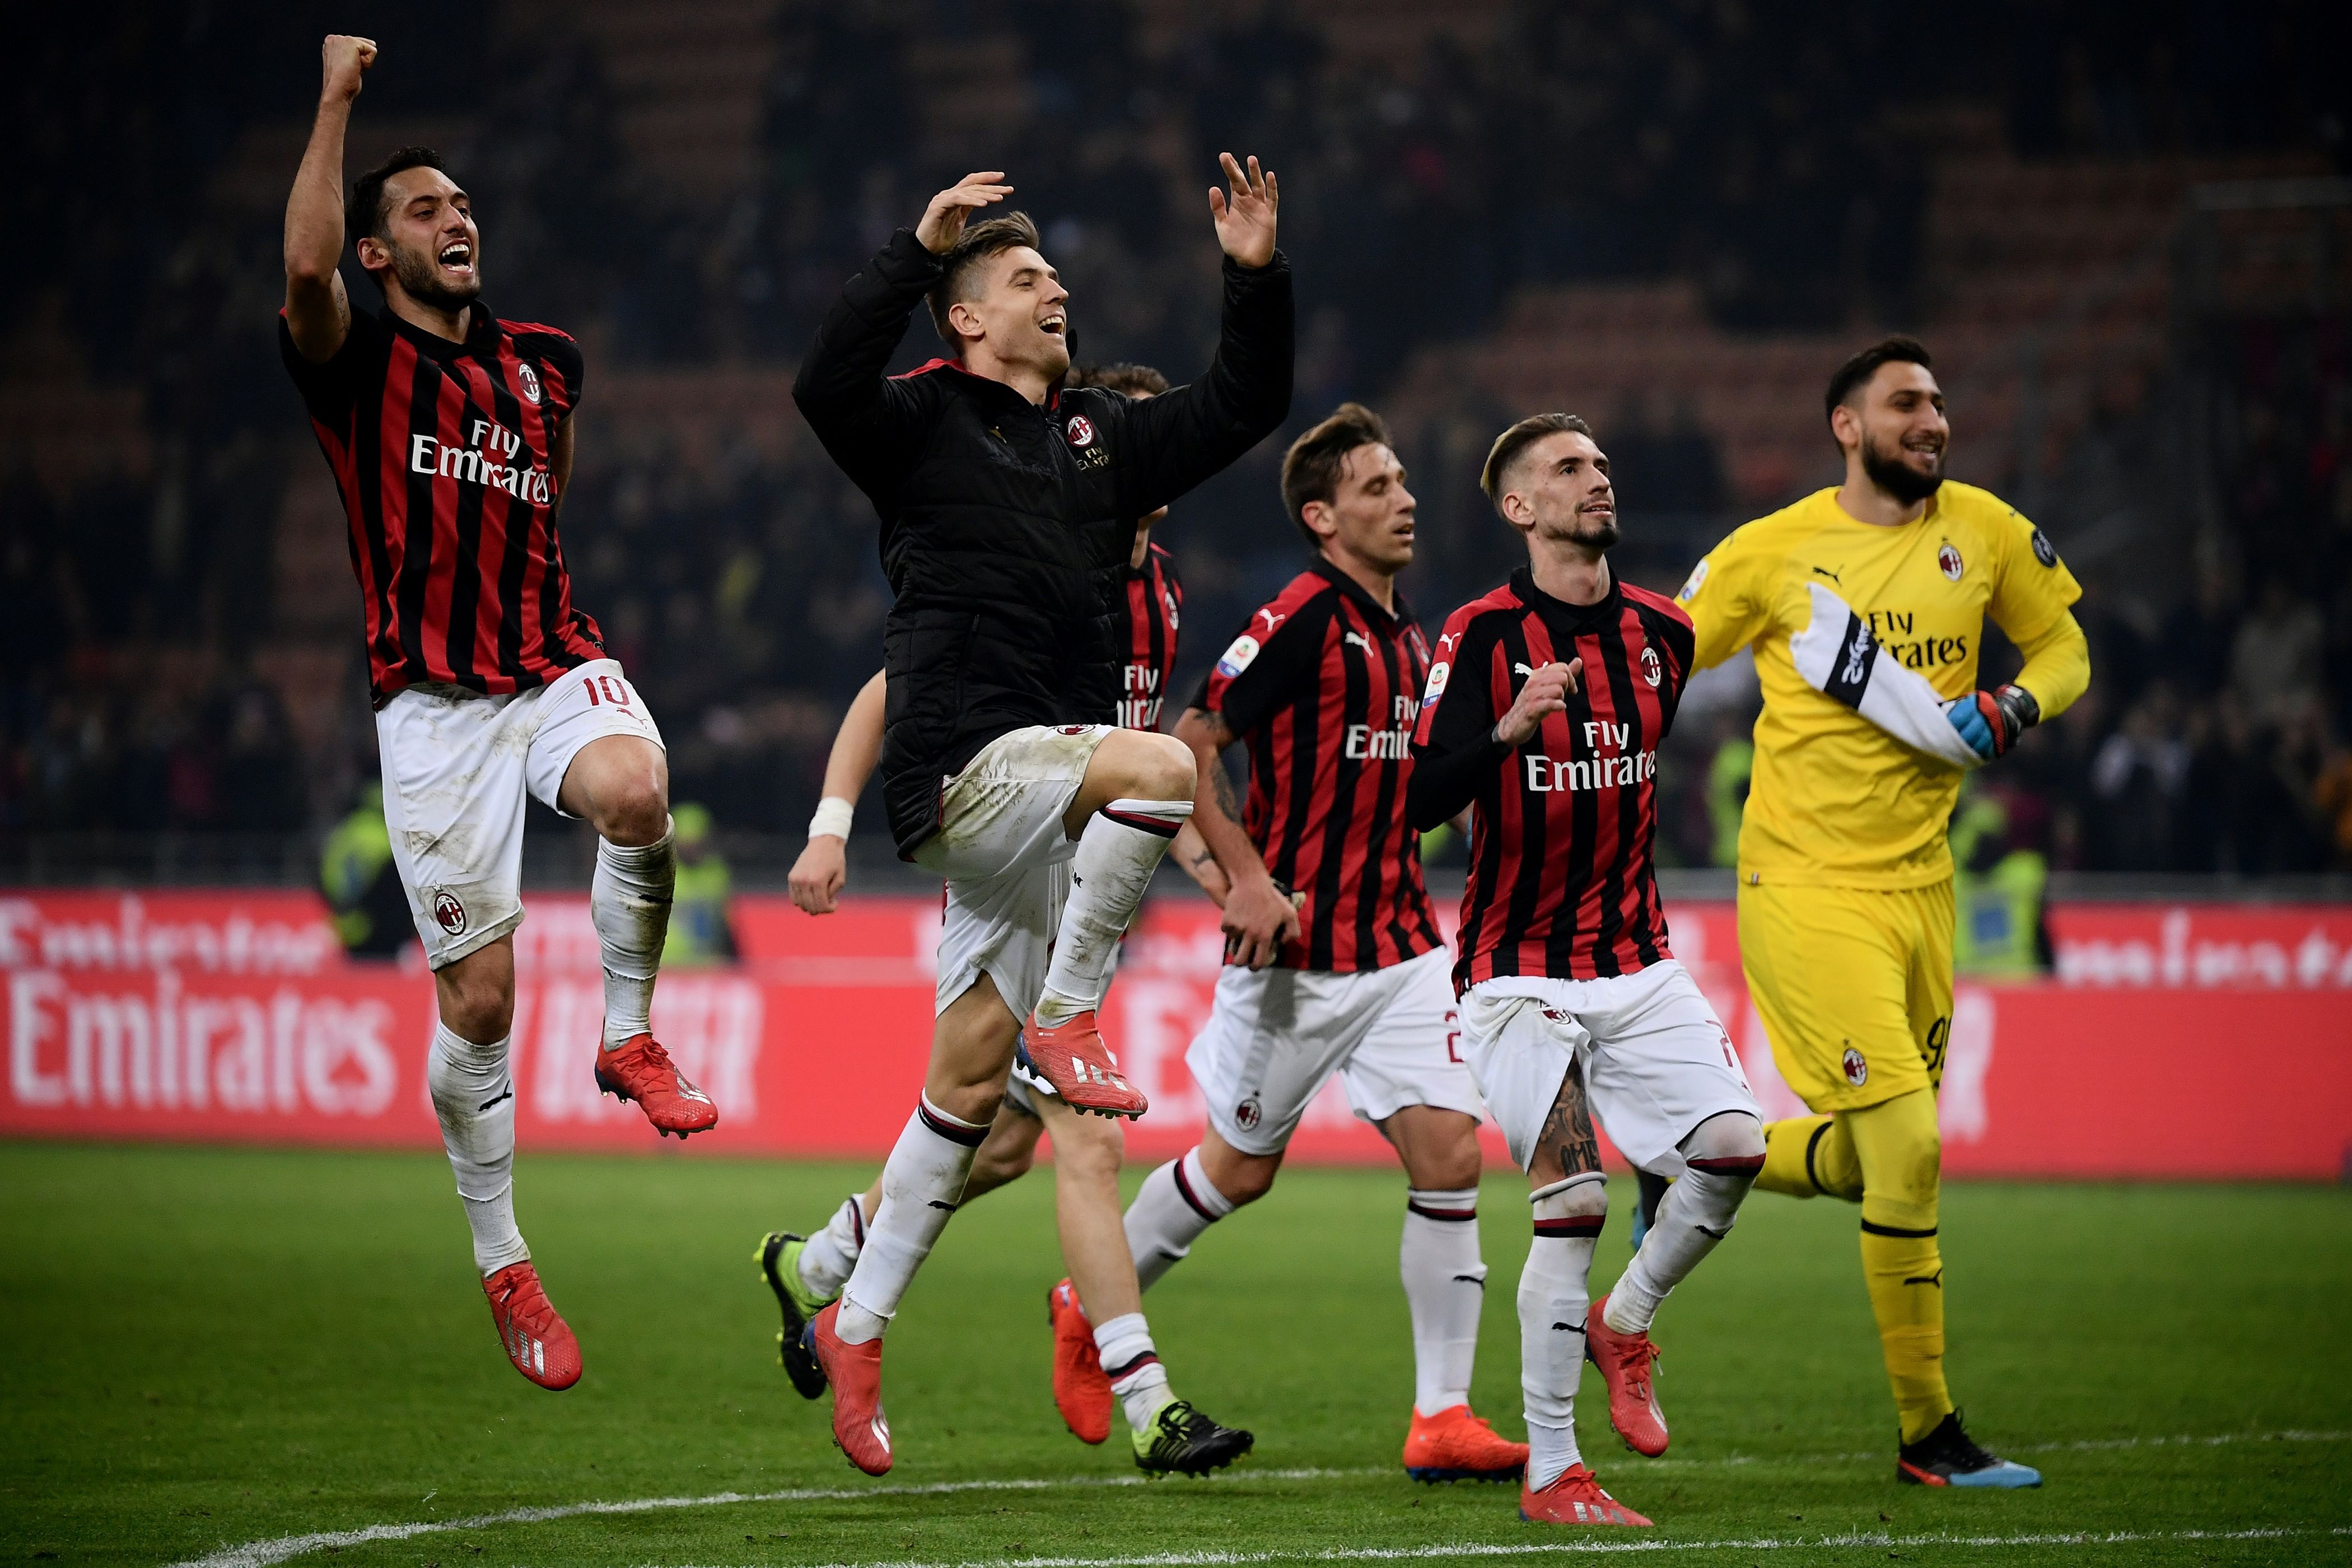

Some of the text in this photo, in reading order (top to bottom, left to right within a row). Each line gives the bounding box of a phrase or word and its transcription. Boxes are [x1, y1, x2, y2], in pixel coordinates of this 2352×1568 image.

[472, 419, 520, 459] Fly
[1085, 447, 1103, 459] Fly
[412, 433, 549, 502] Emirates
[1869, 610, 1913, 636] Fly
[1878, 634, 1967, 669] rates
[584, 675, 630, 706] 10
[1124, 665, 1159, 694] Fly
[1394, 695, 1420, 725] Fly
[1345, 721, 1415, 760] Emir
[1583, 720, 1629, 750] Fly
[1525, 748, 1656, 791] Emirate
[437, 897, 452, 907] ACM
[450, 923, 463, 932] 1899
[8, 963, 396, 1116] Emirates
[1927, 1017, 1952, 1071] 9
